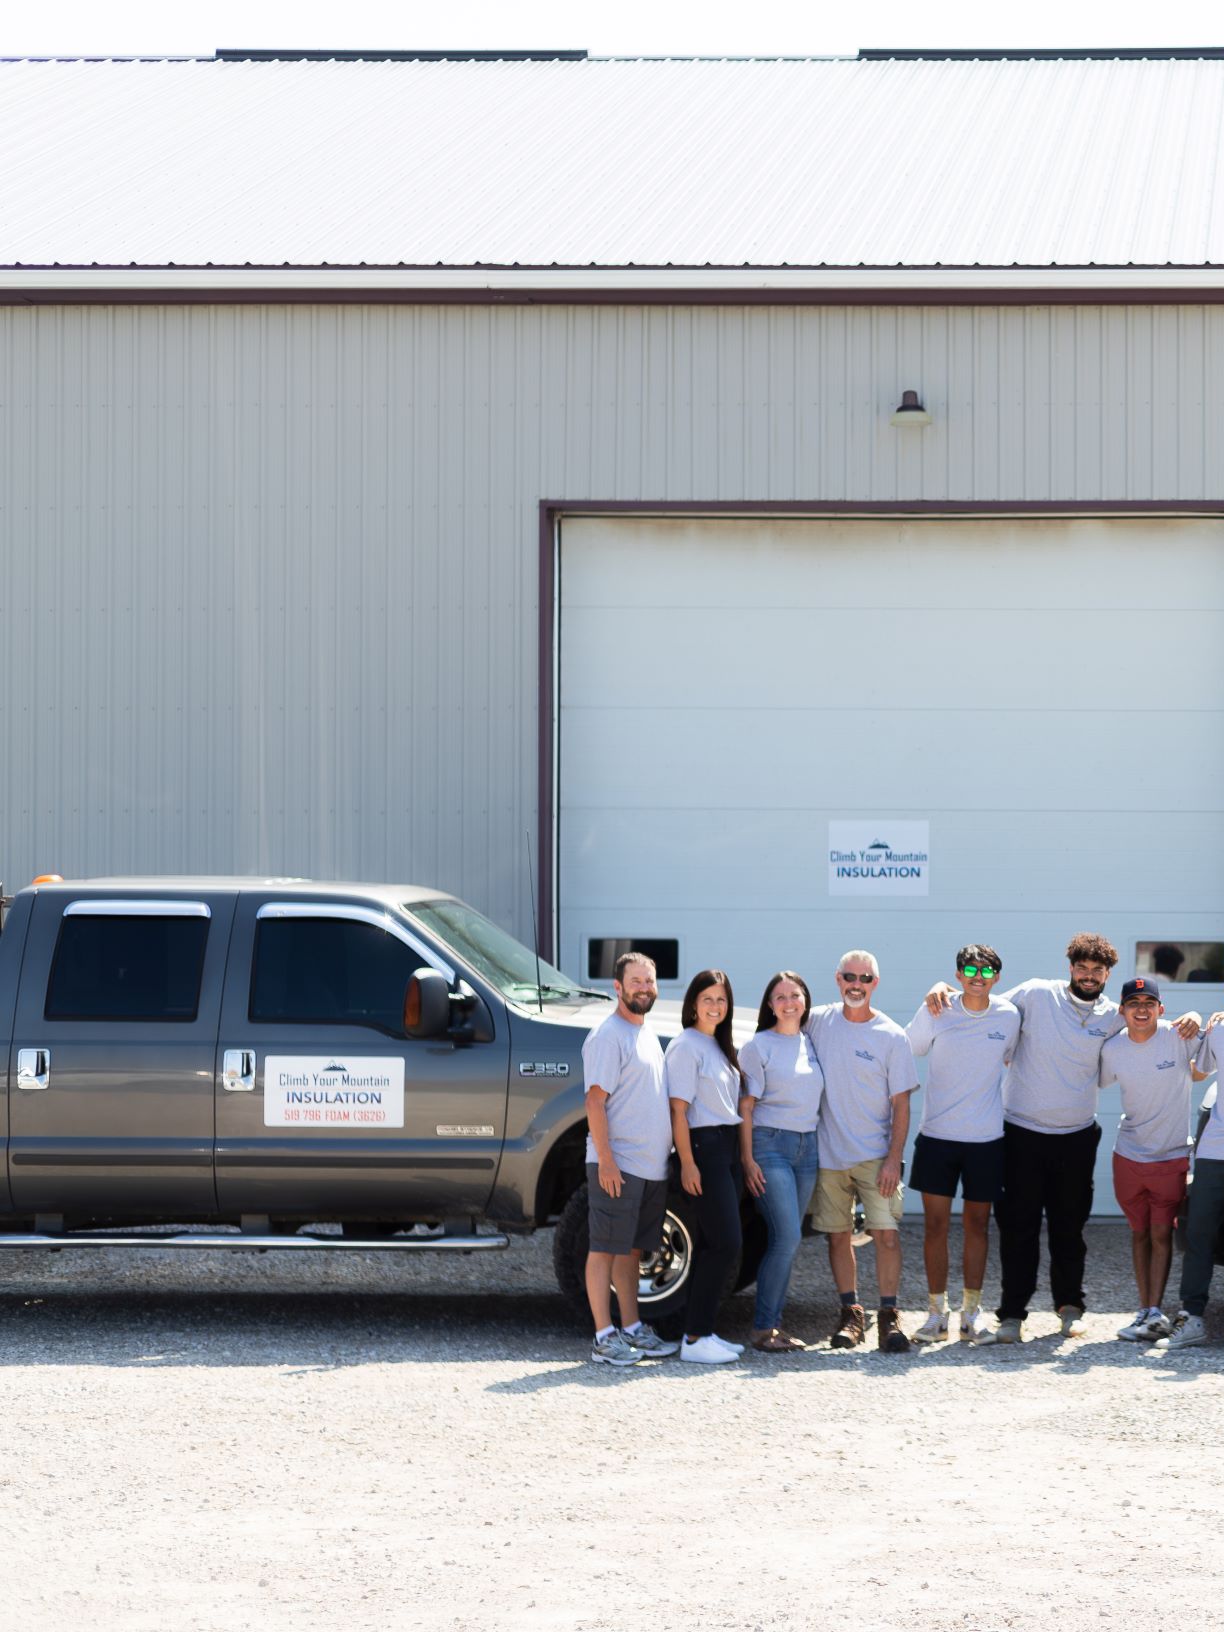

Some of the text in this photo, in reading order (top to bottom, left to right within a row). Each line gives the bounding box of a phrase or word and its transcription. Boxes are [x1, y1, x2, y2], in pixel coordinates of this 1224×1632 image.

[830, 850, 928, 863] Climb Your Mountain
[836, 866, 921, 879] INSULATION
[279, 1073, 390, 1087] Climb Your Mountain
[286, 1091, 382, 1105] INSULATION
[284, 1109, 386, 1122] 519 796 FOAM (3626)
